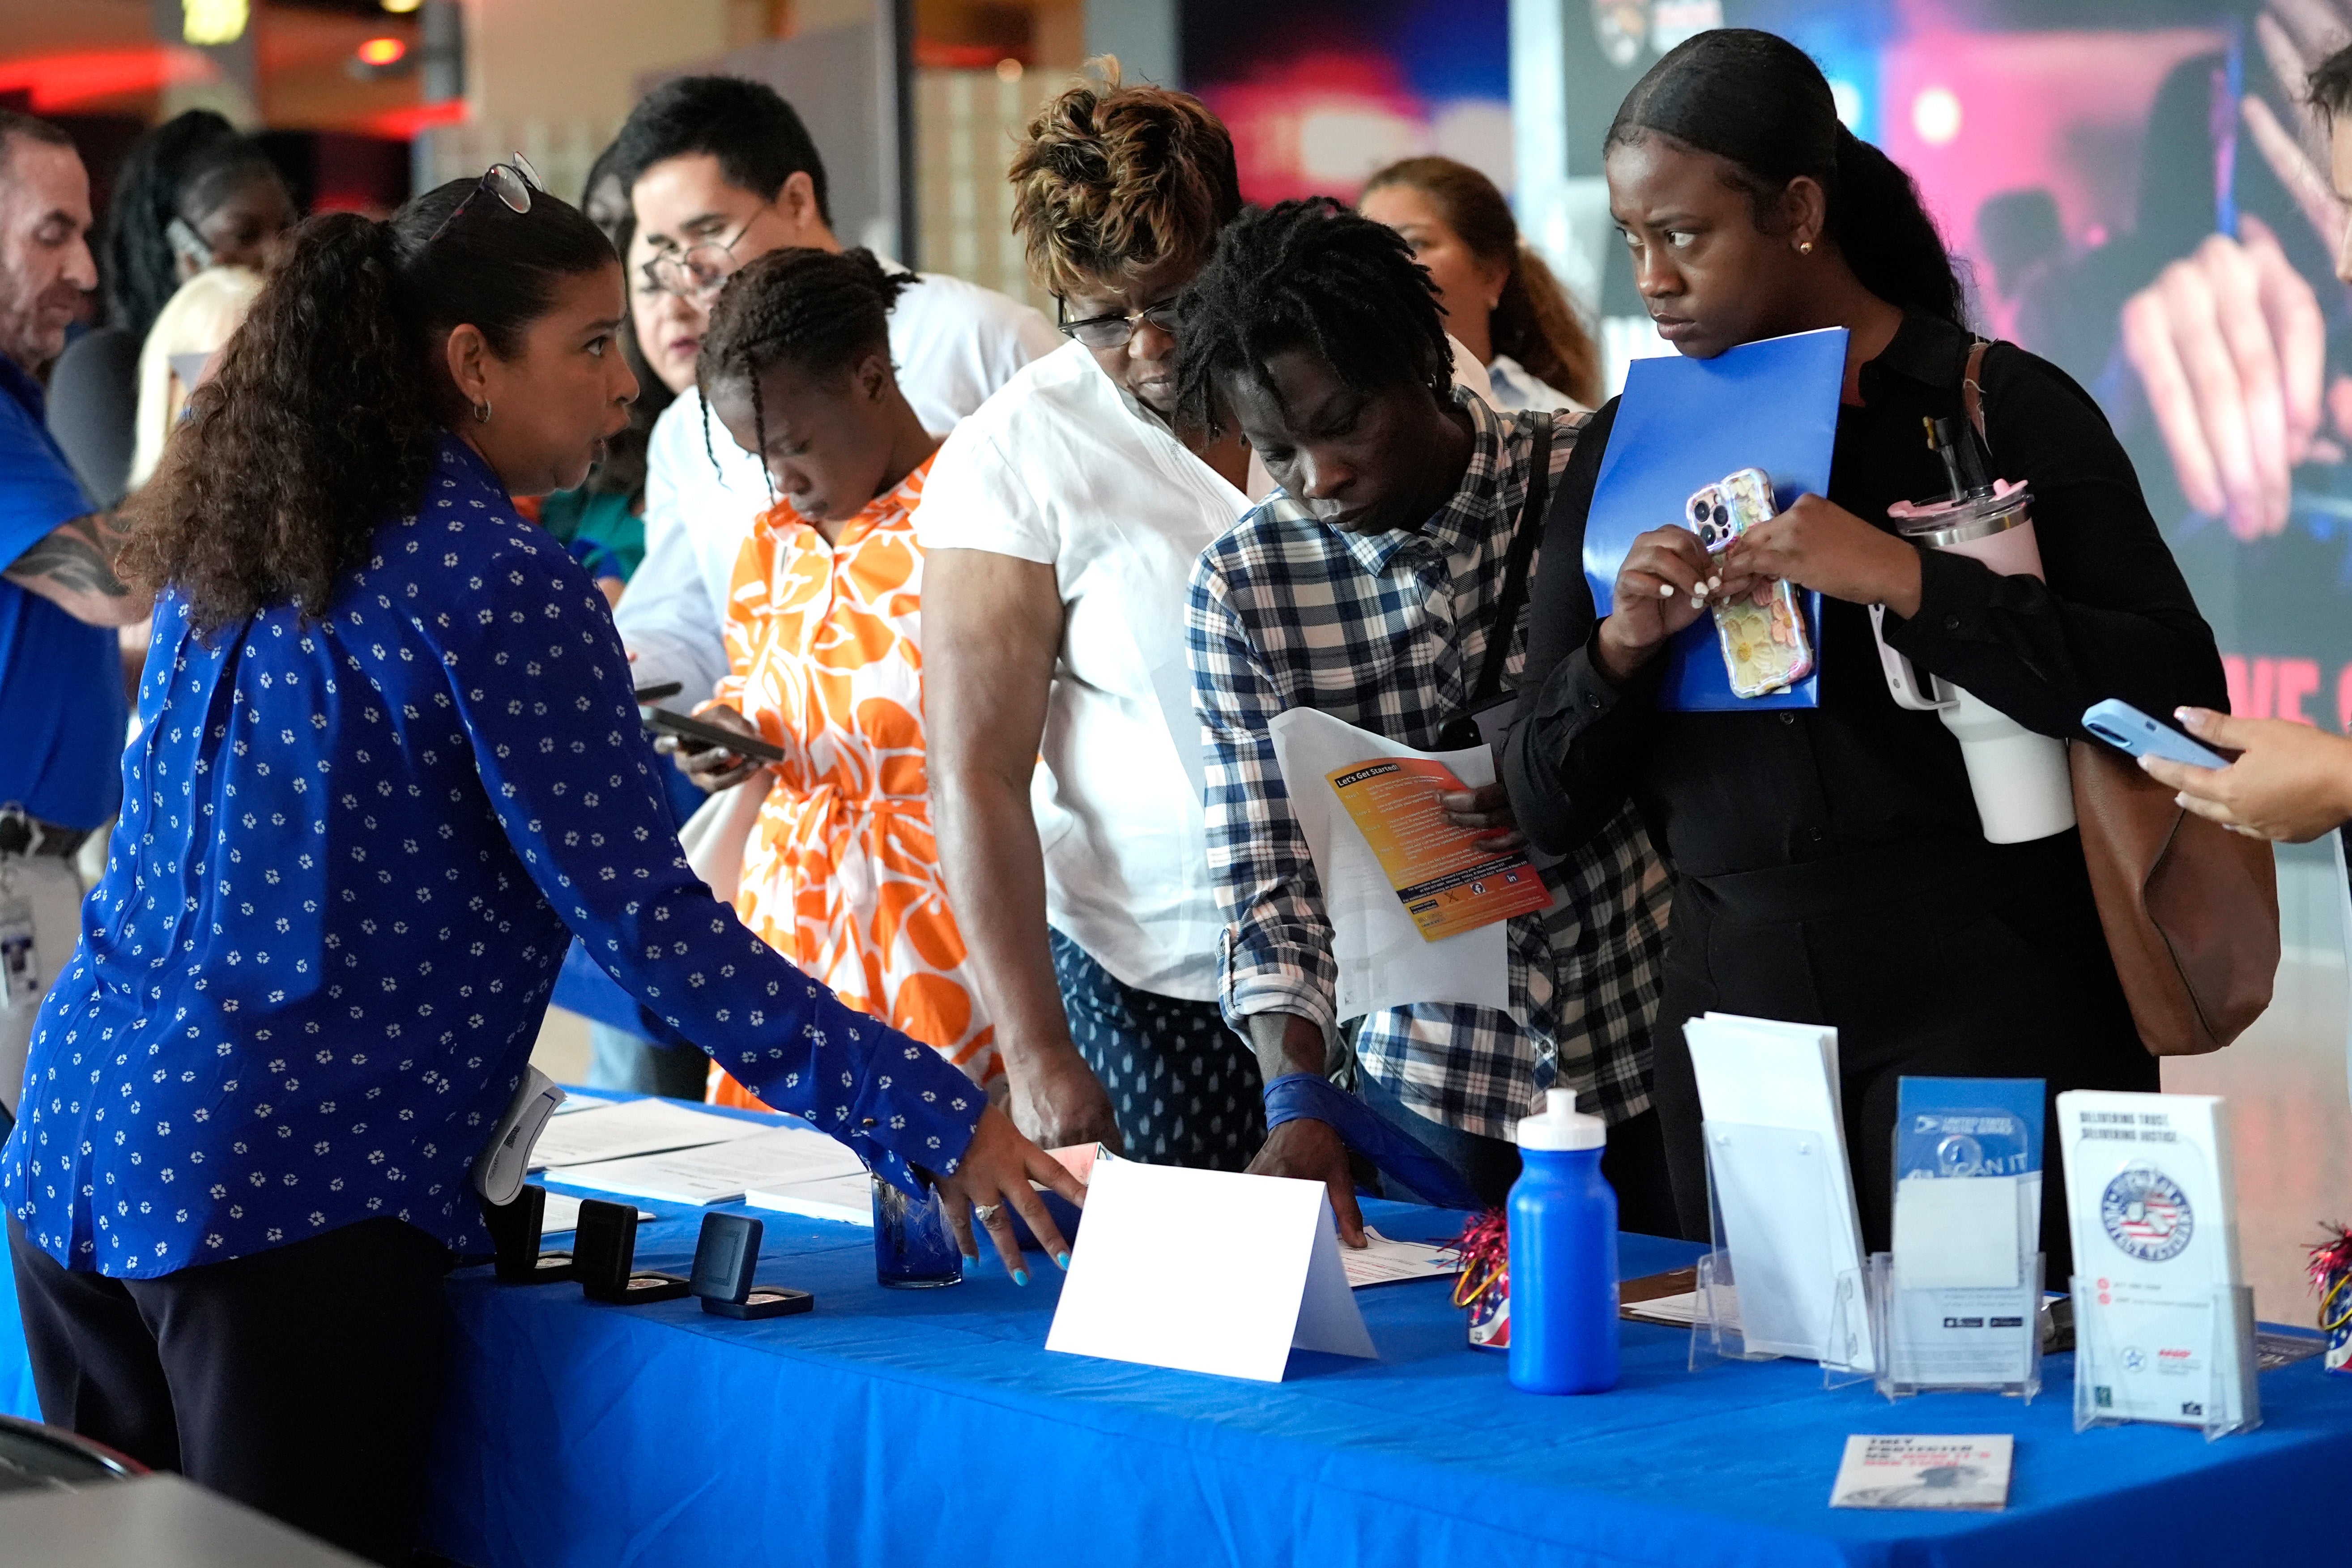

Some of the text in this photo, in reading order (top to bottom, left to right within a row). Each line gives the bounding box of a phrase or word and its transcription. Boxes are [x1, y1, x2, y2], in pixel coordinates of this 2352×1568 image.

[1337, 764, 1399, 787] Let's Get Started!
